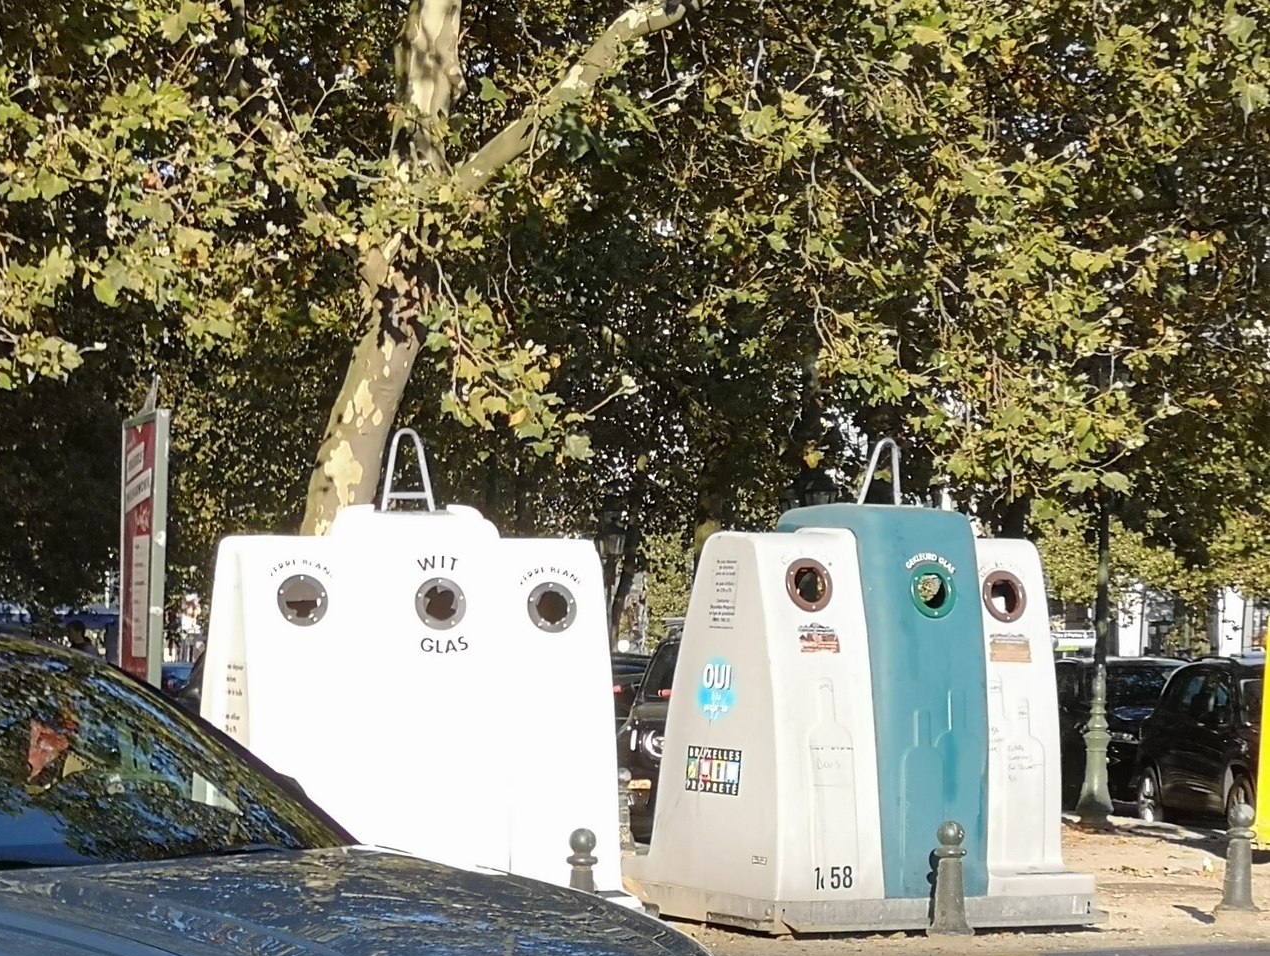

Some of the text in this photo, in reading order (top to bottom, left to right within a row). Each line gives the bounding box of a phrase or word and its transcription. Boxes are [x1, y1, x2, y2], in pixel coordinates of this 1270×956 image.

[417, 555, 459, 571] WIT
[938, 556, 956, 574] GLAS
[420, 636, 469, 653] GLAS
[702, 663, 732, 690] OUI
[688, 746, 741, 762] BRUXELLES
